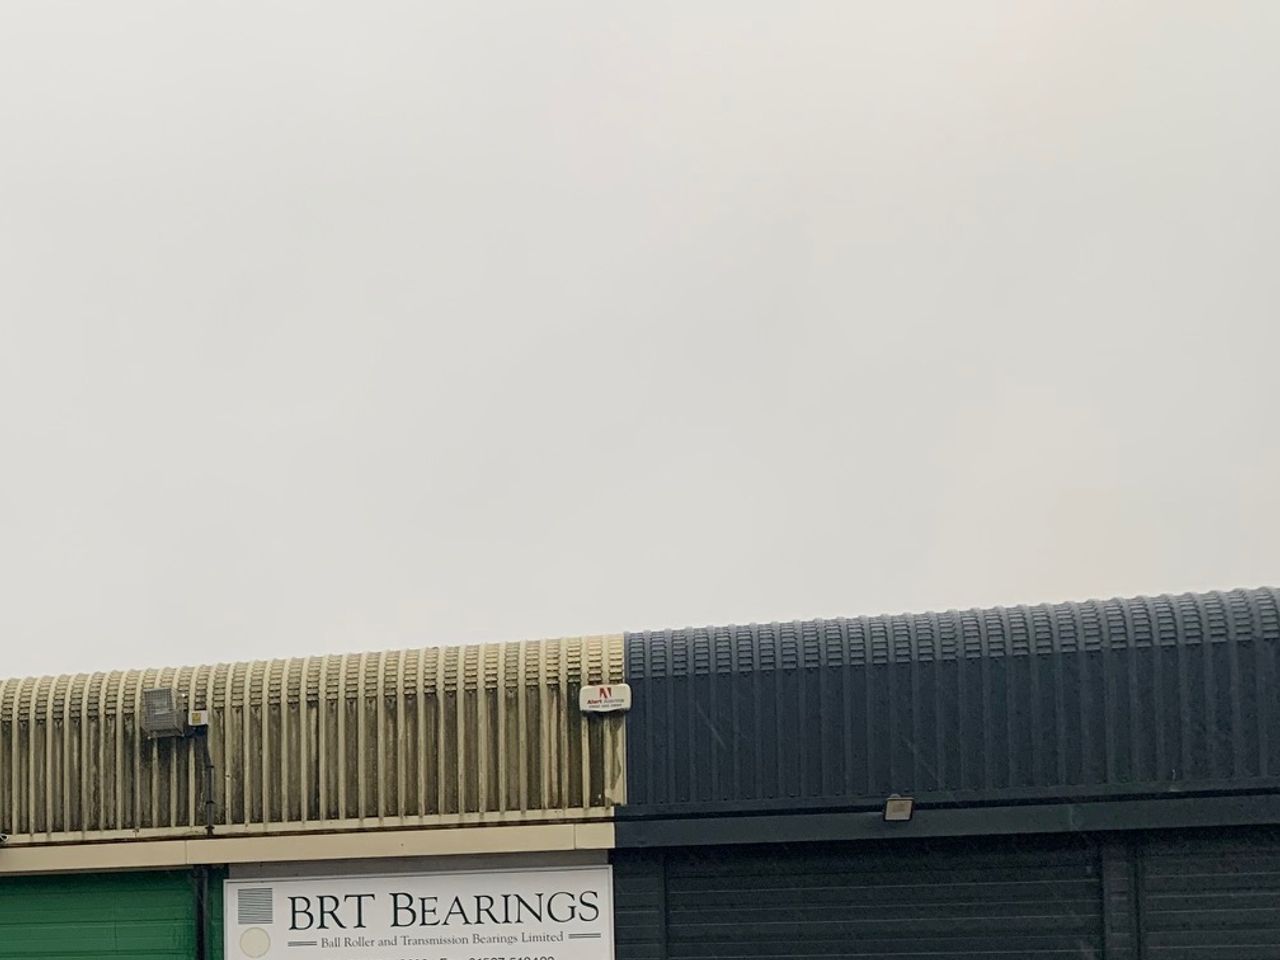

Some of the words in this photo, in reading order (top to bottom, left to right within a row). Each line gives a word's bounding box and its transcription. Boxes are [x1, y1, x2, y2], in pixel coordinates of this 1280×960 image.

[287, 893, 375, 931] BRT
[389, 890, 600, 928] BEARINGS
[321, 937, 341, 948] Ball
[344, 936, 375, 947] Roller
[378, 935, 398, 946] and
[400, 934, 469, 946] Transmission
[472, 933, 518, 945] Bearings
[521, 931, 564, 943] Limited
